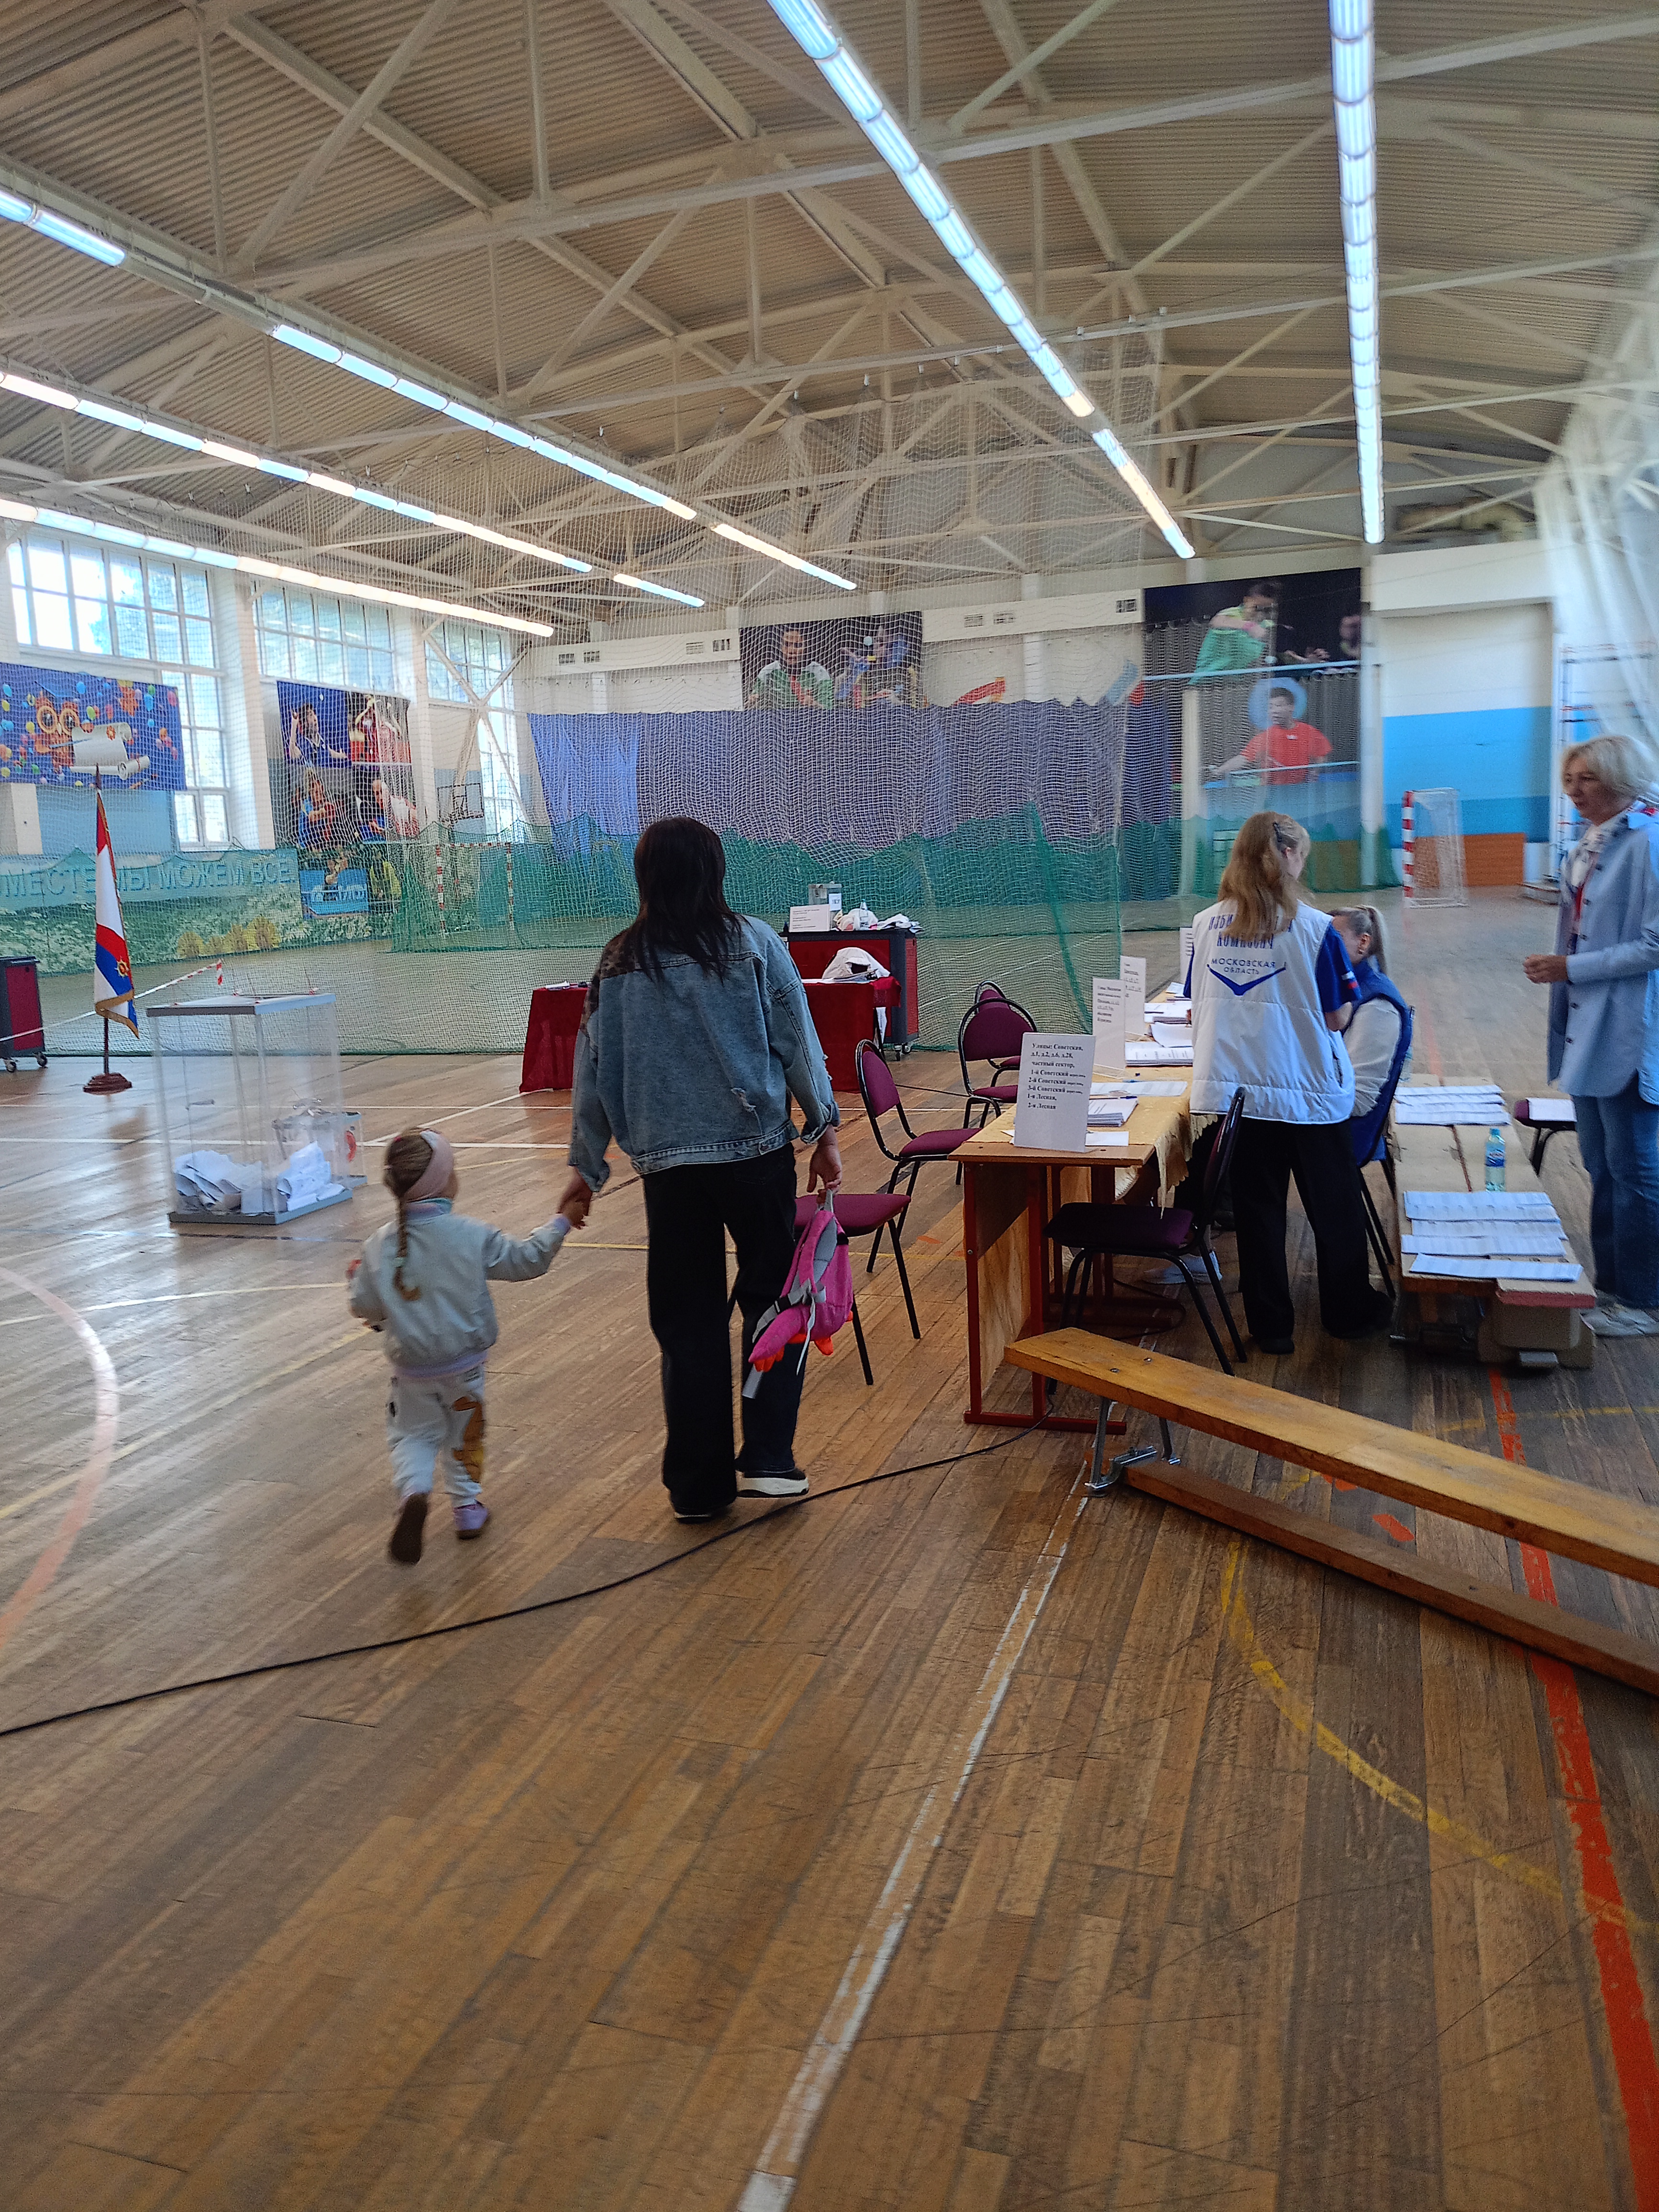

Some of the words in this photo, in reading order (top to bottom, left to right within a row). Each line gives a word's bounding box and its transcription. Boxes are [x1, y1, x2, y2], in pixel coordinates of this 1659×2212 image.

[0, 868, 97, 896] МЕСТЕ
[158, 861, 245, 889] МОЖЕМ
[1211, 958, 1276, 968] МОСКОВСКАЯ
[1223, 967, 1260, 975] ОБЛАСТЬ
